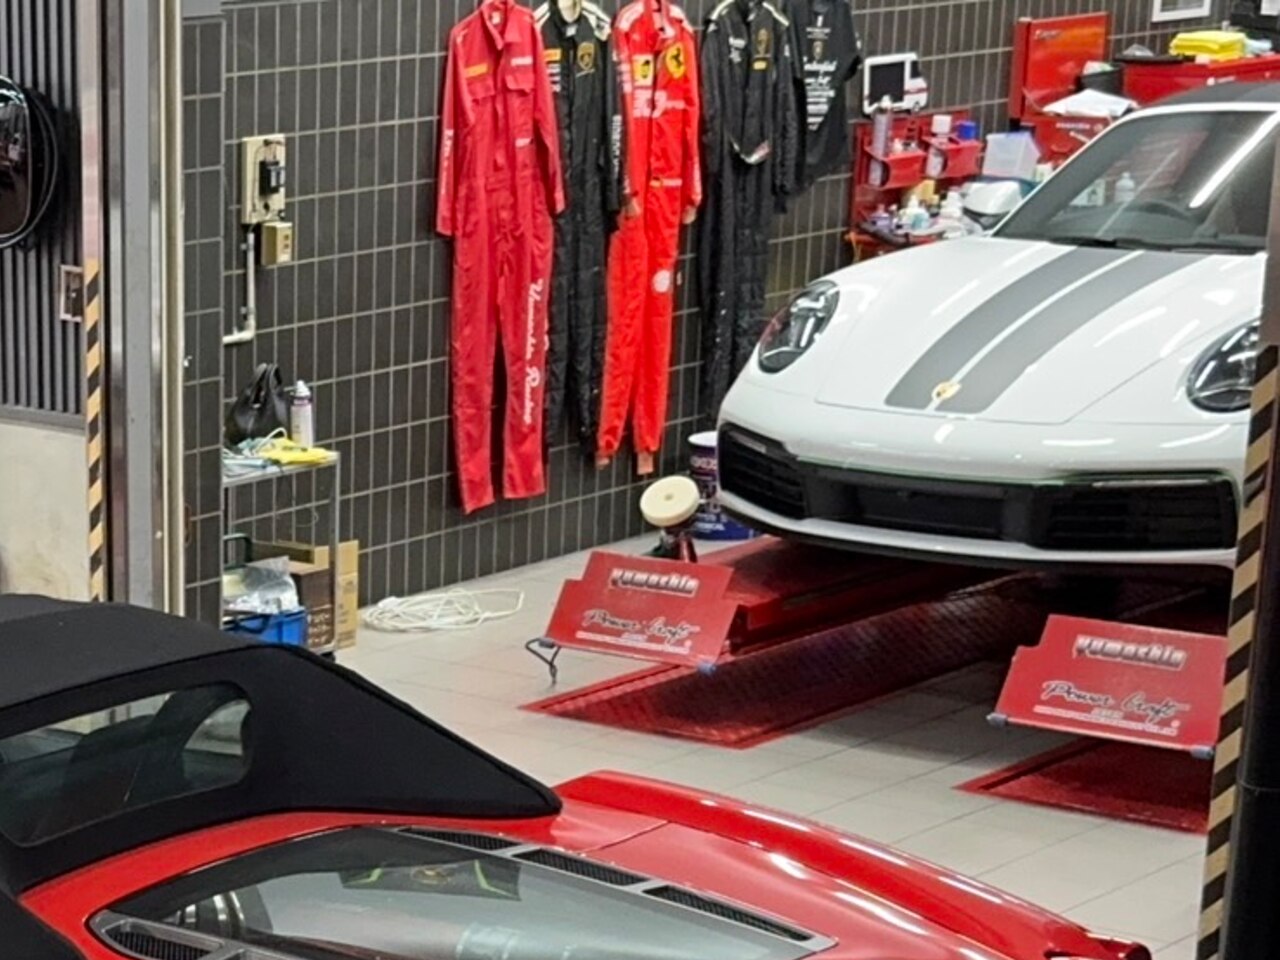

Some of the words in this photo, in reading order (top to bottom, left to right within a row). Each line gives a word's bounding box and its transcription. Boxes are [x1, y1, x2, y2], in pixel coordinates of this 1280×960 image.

[582, 609, 641, 627] Power
[645, 616, 701, 644] Craft
[1041, 681, 1115, 706] Power
[1121, 692, 1191, 724] Craft
